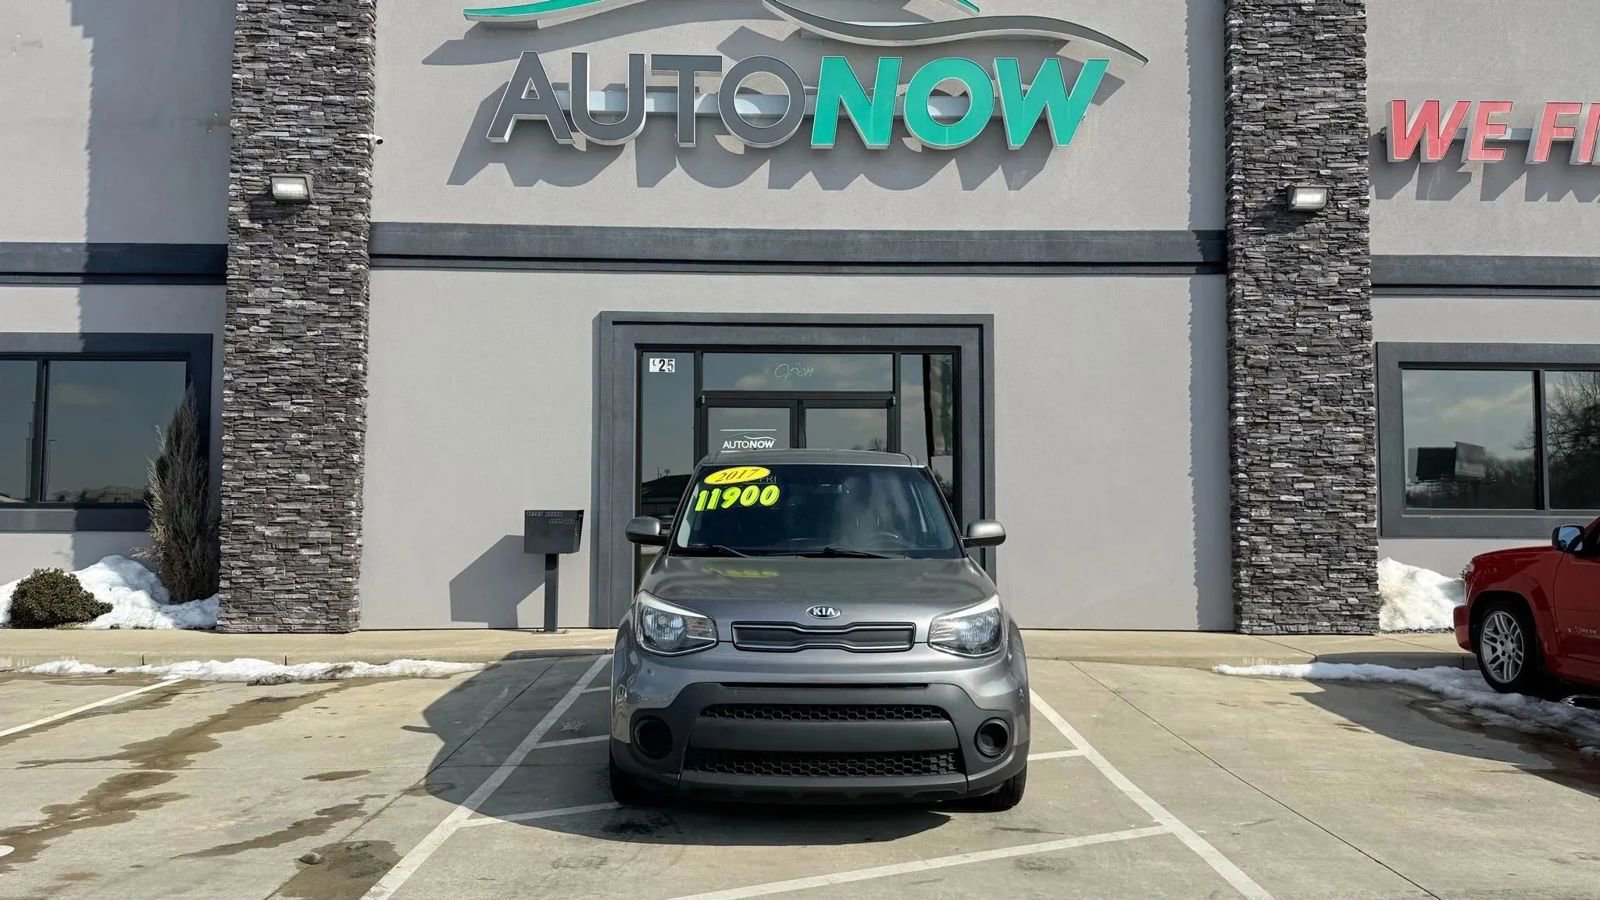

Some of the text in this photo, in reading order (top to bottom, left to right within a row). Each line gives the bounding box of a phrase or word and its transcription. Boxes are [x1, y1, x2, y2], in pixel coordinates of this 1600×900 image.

[1387, 99, 1513, 163] WE
[714, 468, 761, 482] 2017
[694, 484, 780, 512] 11900
[812, 607, 836, 616] KIA
